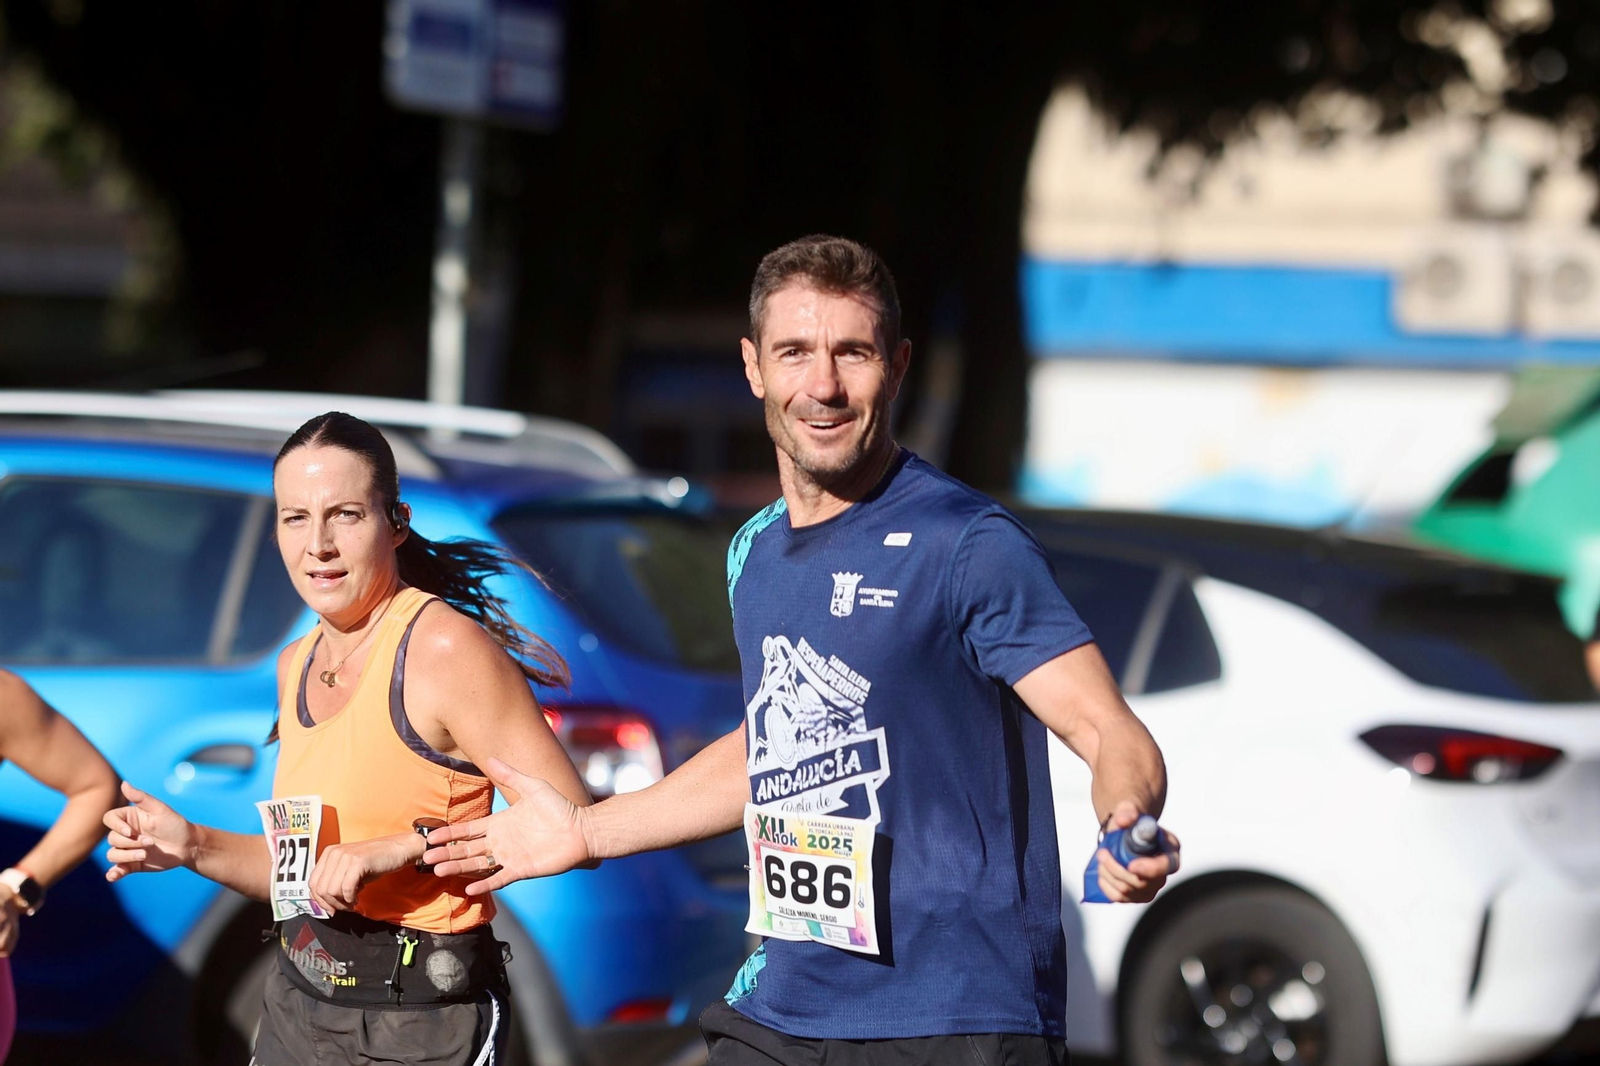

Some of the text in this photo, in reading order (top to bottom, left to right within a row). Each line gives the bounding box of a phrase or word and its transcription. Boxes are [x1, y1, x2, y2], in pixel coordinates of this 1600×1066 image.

[797, 636, 868, 706] DESPEÑAPERROS
[827, 654, 872, 693] SANTA ELENA
[756, 748, 862, 802] ANDALUCÍA
[816, 793, 832, 808] de
[756, 813, 785, 843] XII
[775, 832, 798, 847] 10k
[807, 821, 832, 829] CARRERA
[806, 834, 853, 852] 2025
[276, 837, 310, 882] 227
[764, 855, 853, 909] 686
[329, 975, 356, 987] Trail
